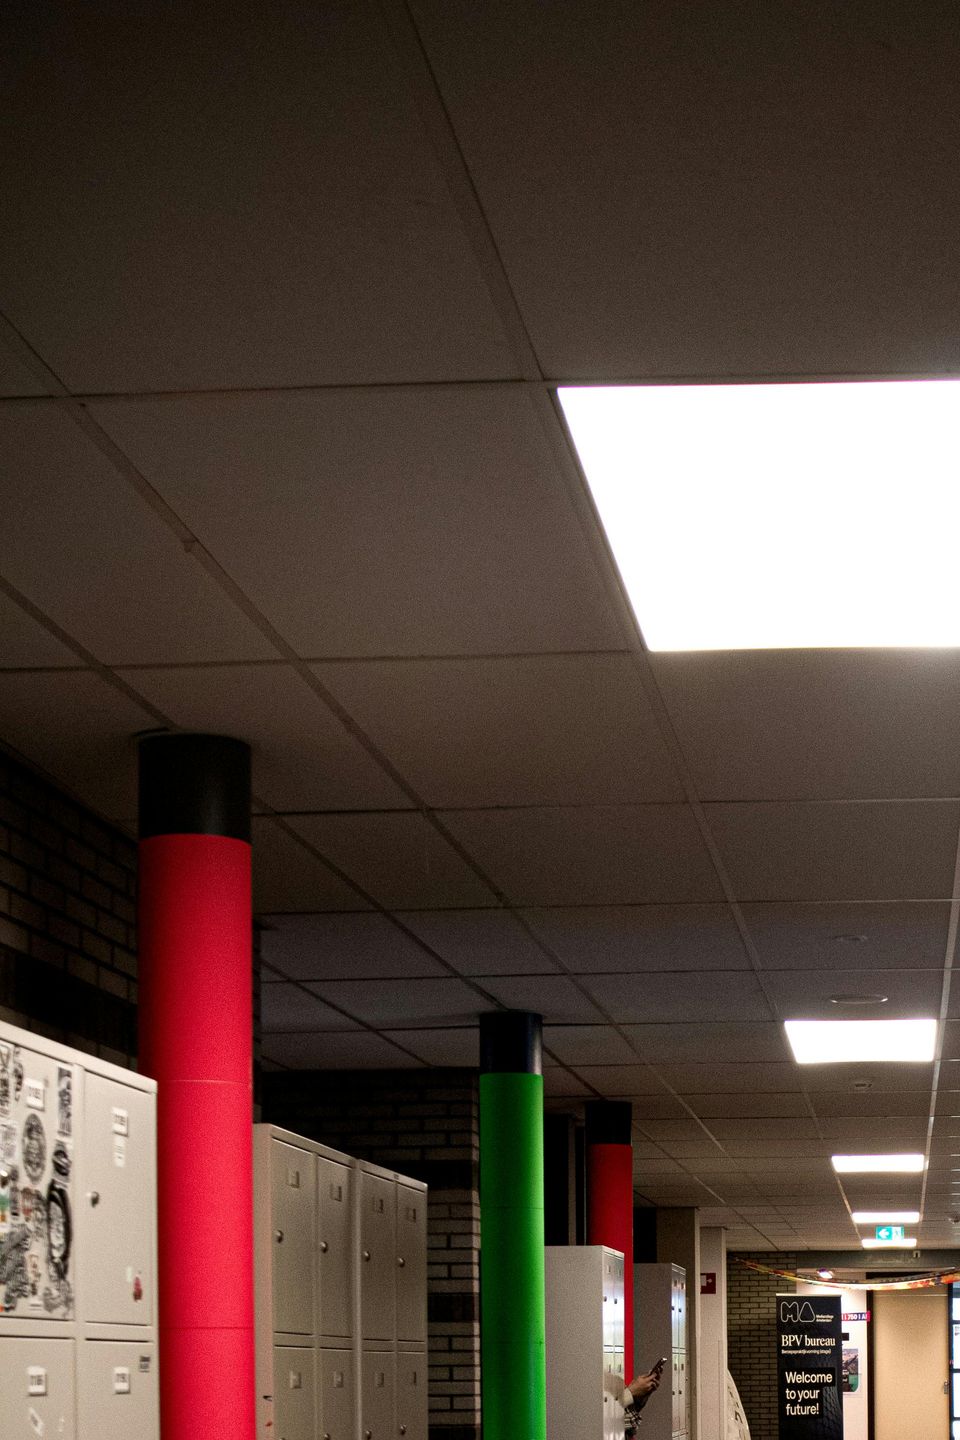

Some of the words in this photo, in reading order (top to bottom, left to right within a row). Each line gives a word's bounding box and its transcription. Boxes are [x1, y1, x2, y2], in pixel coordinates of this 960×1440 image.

[781, 1334, 803, 1347] BPV
[804, 1334, 836, 1347] bureau
[785, 1371, 833, 1384] Welcome
[785, 1388, 797, 1400] to
[797, 1389, 820, 1403] your
[785, 1402, 820, 1416] future!
